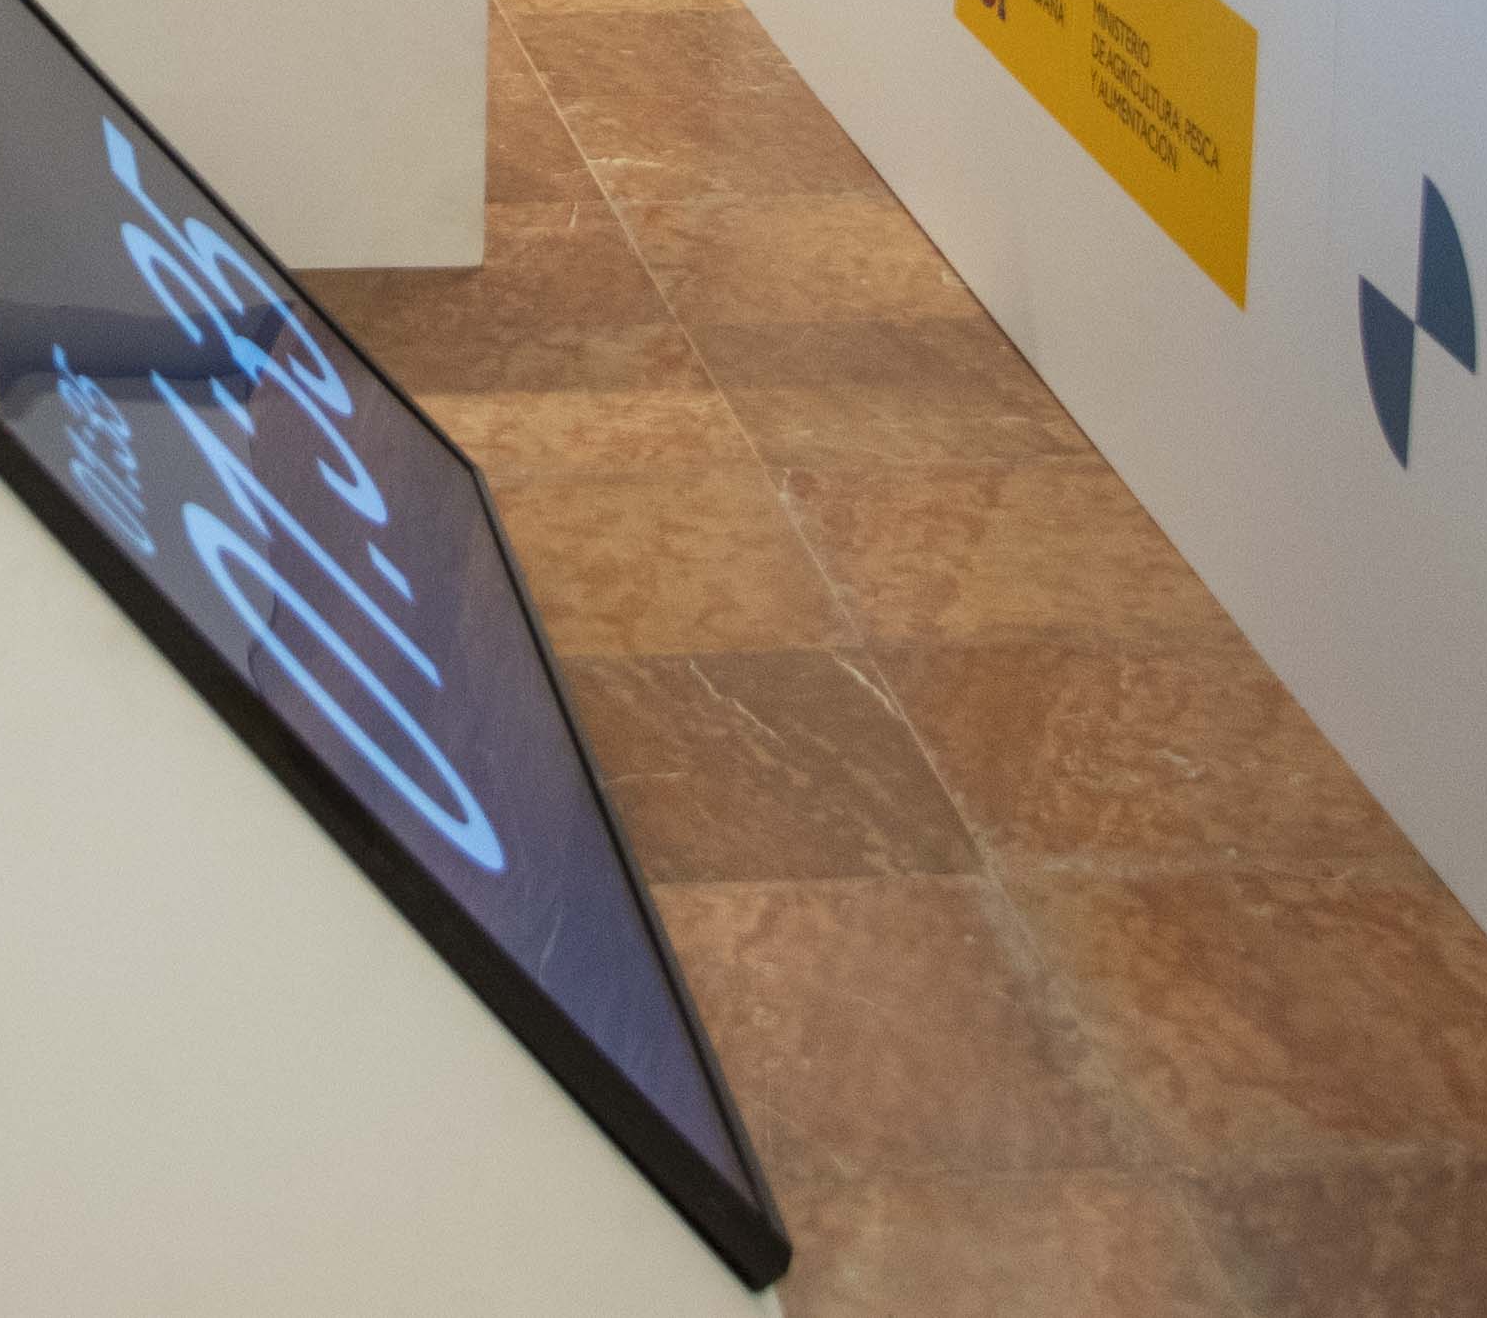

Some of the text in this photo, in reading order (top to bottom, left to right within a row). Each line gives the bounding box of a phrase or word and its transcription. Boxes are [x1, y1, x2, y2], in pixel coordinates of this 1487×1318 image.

[1091, 32, 1105, 65] DE
[1184, 117, 1220, 171] PESCA
[1098, 74, 1178, 172] ALIMENTACIÓN
